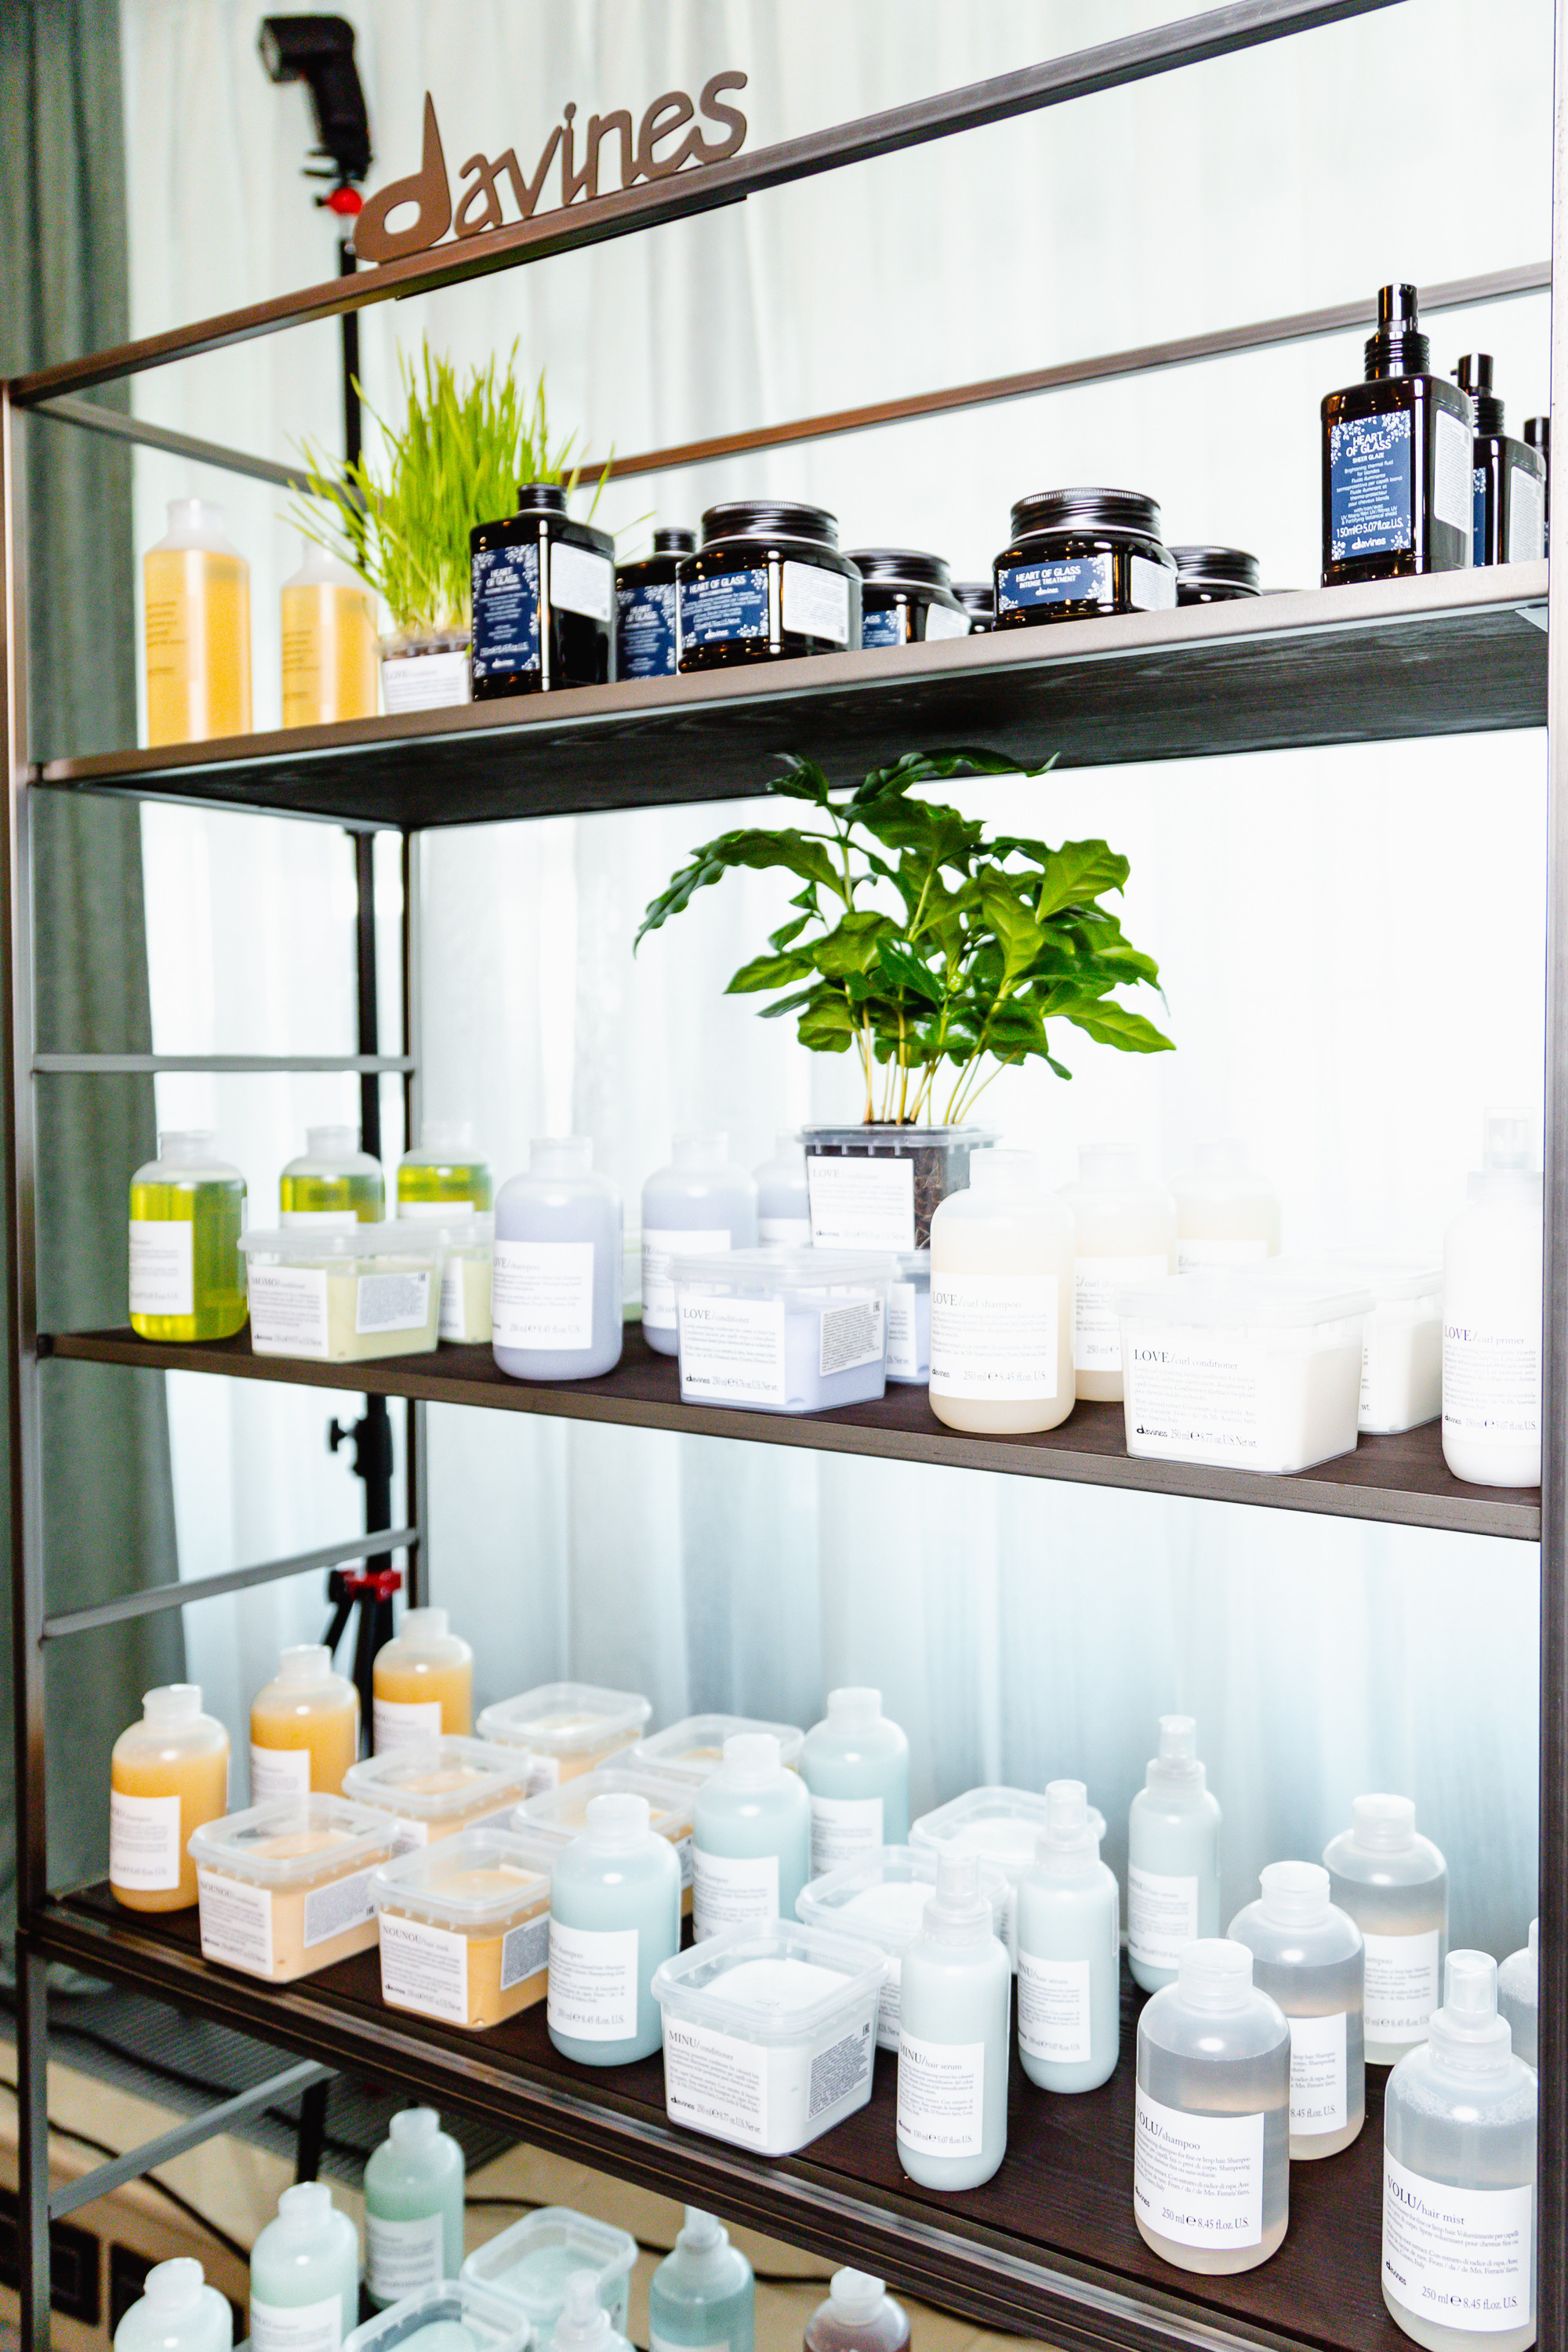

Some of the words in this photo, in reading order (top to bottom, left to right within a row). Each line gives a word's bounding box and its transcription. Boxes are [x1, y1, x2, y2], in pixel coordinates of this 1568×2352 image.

[353, 71, 748, 265] davines
[1353, 430, 1384, 446] HEART
[1346, 445, 1358, 457] OF
[1360, 439, 1392, 454] GLASS
[1352, 456, 1367, 464] SHEER
[1368, 452, 1385, 460] GLAZE
[1352, 536, 1386, 550] davines
[1015, 571, 1040, 583] HEART
[1041, 568, 1052, 578] OF
[1054, 565, 1081, 577] GLASS
[1019, 579, 1041, 589] INTENSE
[1042, 575, 1076, 585] TREATMENT
[689, 581, 710, 594] HEART
[710, 579, 720, 589] OF
[720, 575, 746, 587] GLASS
[1192, 1358, 1238, 1370] conditioner
[1136, 1424, 1167, 1438] davines
[1388, 2175, 1440, 2220] VOLU/hair
[1443, 2214, 1465, 2225] mist
[1162, 2207, 1174, 2220] 250
[1175, 2214, 1185, 2224] ml
[1198, 2217, 1214, 2230] 8.45
[1235, 2216, 1250, 2229] U.S.
[1421, 2285, 1436, 2300] 250
[1438, 2293, 1448, 2304] ml
[1463, 2297, 1481, 2309] 8.45
[1503, 2296, 1518, 2309] U.S.
